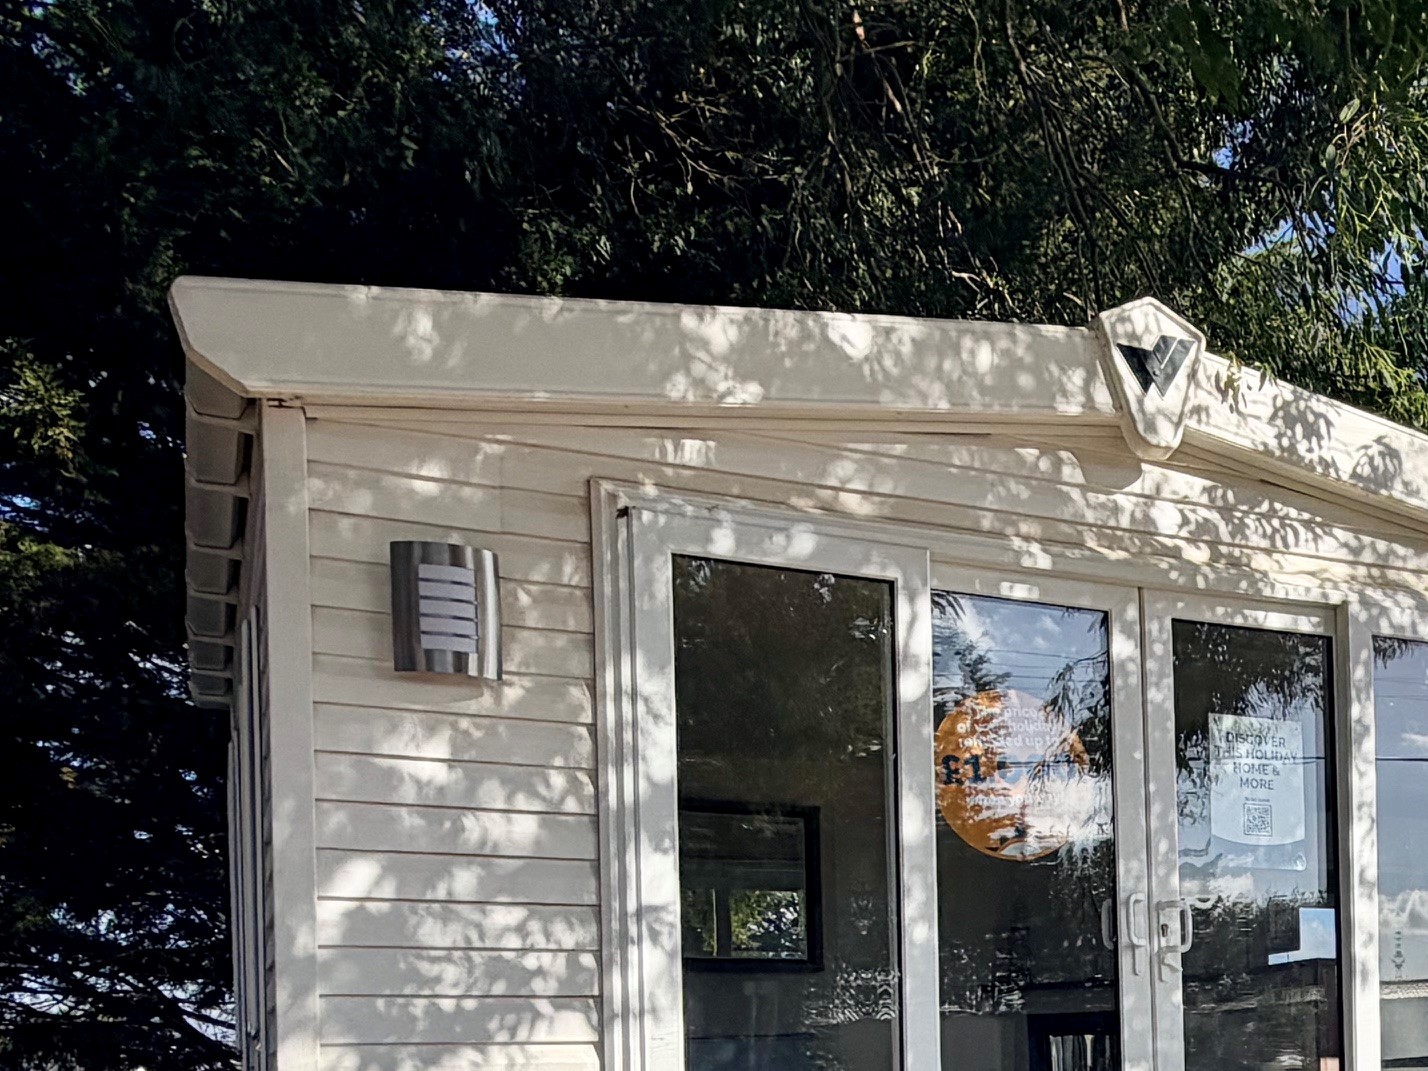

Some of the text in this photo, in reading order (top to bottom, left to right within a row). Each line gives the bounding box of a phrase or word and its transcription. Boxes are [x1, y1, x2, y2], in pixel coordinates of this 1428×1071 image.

[1026, 736, 1043, 750] up
[1226, 731, 1286, 748] DISCOVER
[1214, 744, 1298, 763] THIS HOLIDAY
[1233, 761, 1280, 777] HOME &
[1240, 776, 1275, 791] MORE
